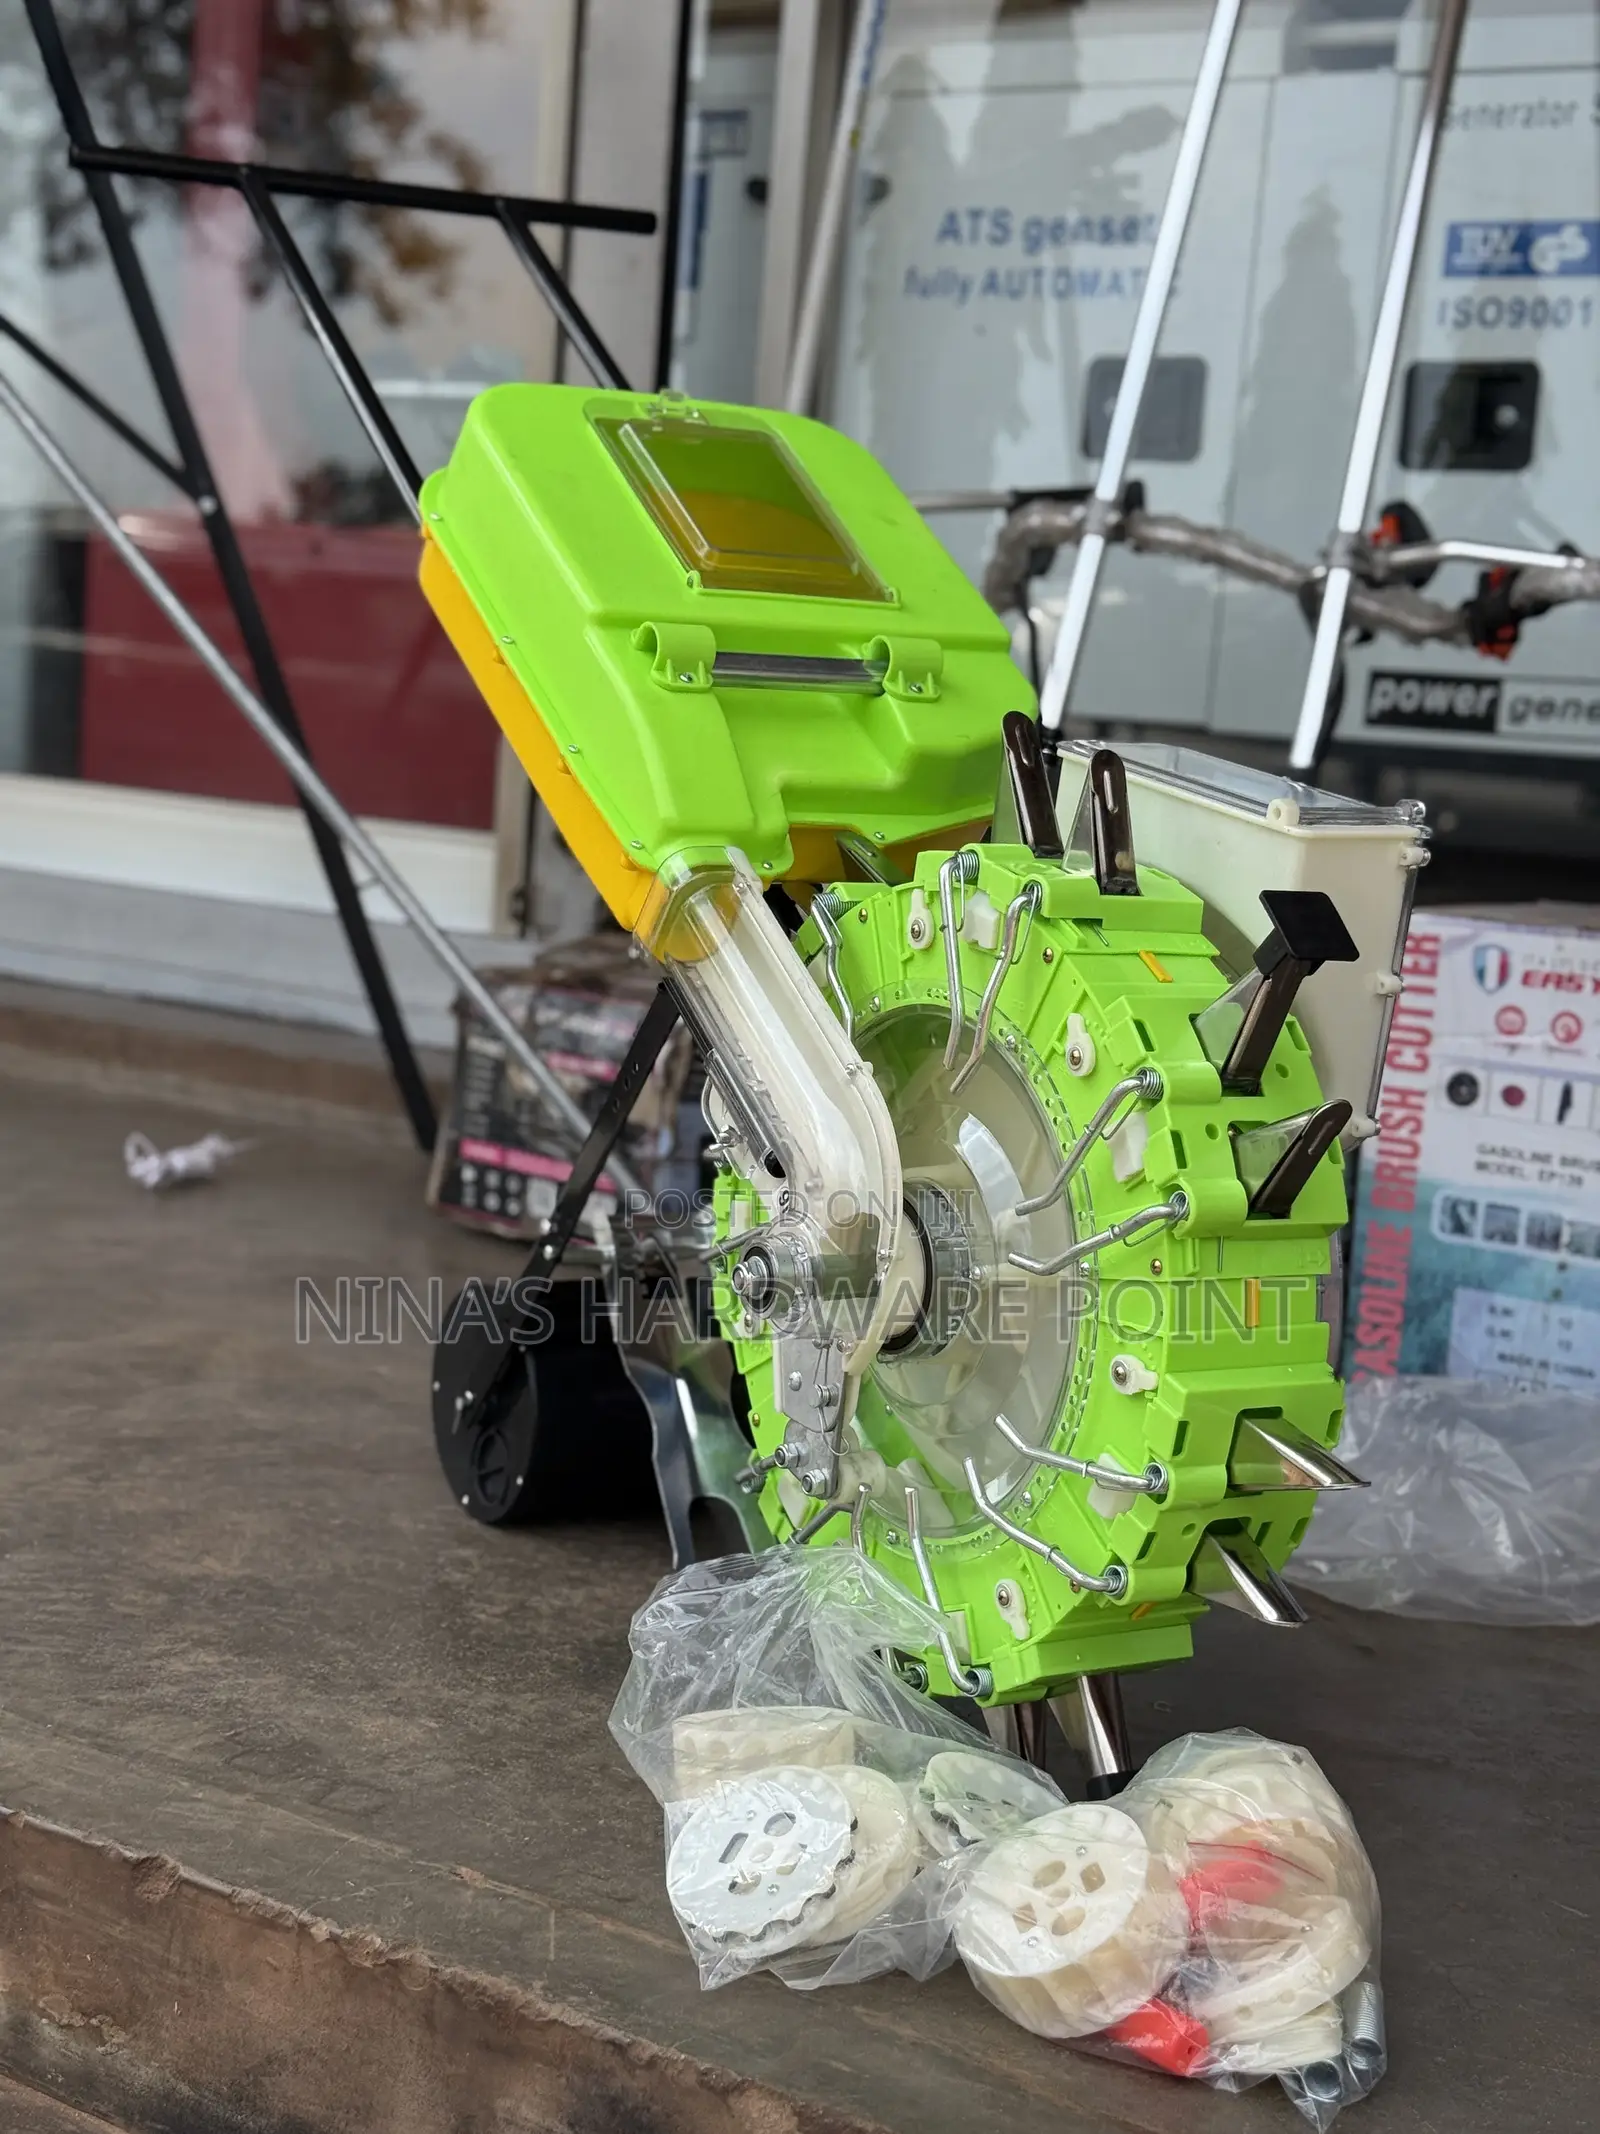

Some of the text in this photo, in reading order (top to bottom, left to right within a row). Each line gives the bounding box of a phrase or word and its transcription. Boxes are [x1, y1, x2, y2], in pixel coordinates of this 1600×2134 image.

[936, 207, 1013, 247] ATS
[981, 267, 1180, 300] AUTOMAT
[1437, 296, 1593, 330] ISO9001
[1369, 677, 1498, 720] power
[1352, 932, 1442, 1383] ASOLINE BRUSH CUTTER
